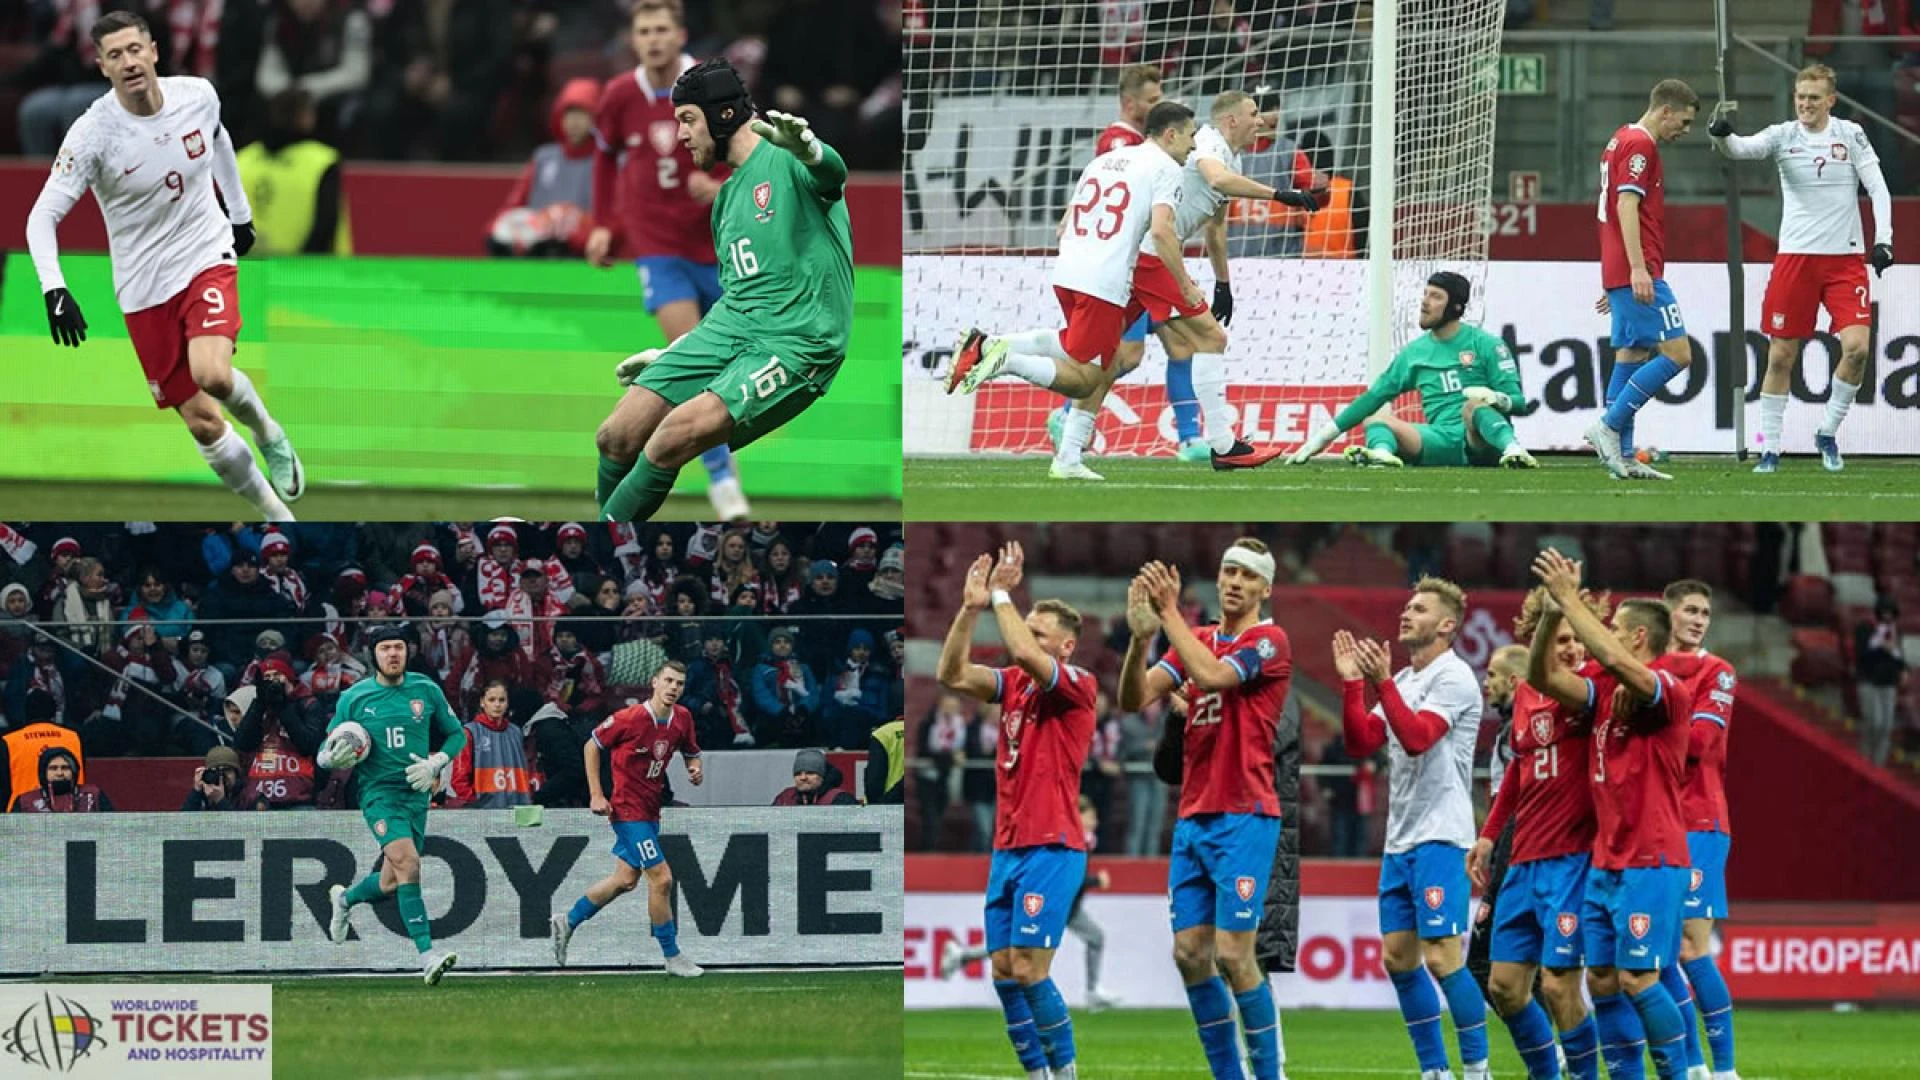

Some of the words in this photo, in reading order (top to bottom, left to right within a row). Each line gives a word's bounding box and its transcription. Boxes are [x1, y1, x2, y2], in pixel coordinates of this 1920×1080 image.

[165, 170, 184, 201] 9
[657, 158, 680, 189] 2
[1073, 178, 1131, 240] 23
[729, 238, 759, 279] 16
[202, 287, 225, 314] 9
[1660, 303, 1683, 331] 18
[749, 355, 787, 398] 16
[1440, 369, 1462, 393] 16
[1192, 692, 1223, 726] 22
[385, 727, 406, 749] 16
[646, 759, 665, 779] 18
[1535, 744, 1558, 780] 21
[493, 768, 517, 790] 61
[637, 840, 659, 862] 18
[66, 835, 590, 943] LEROY
[651, 832, 883, 937] ME
